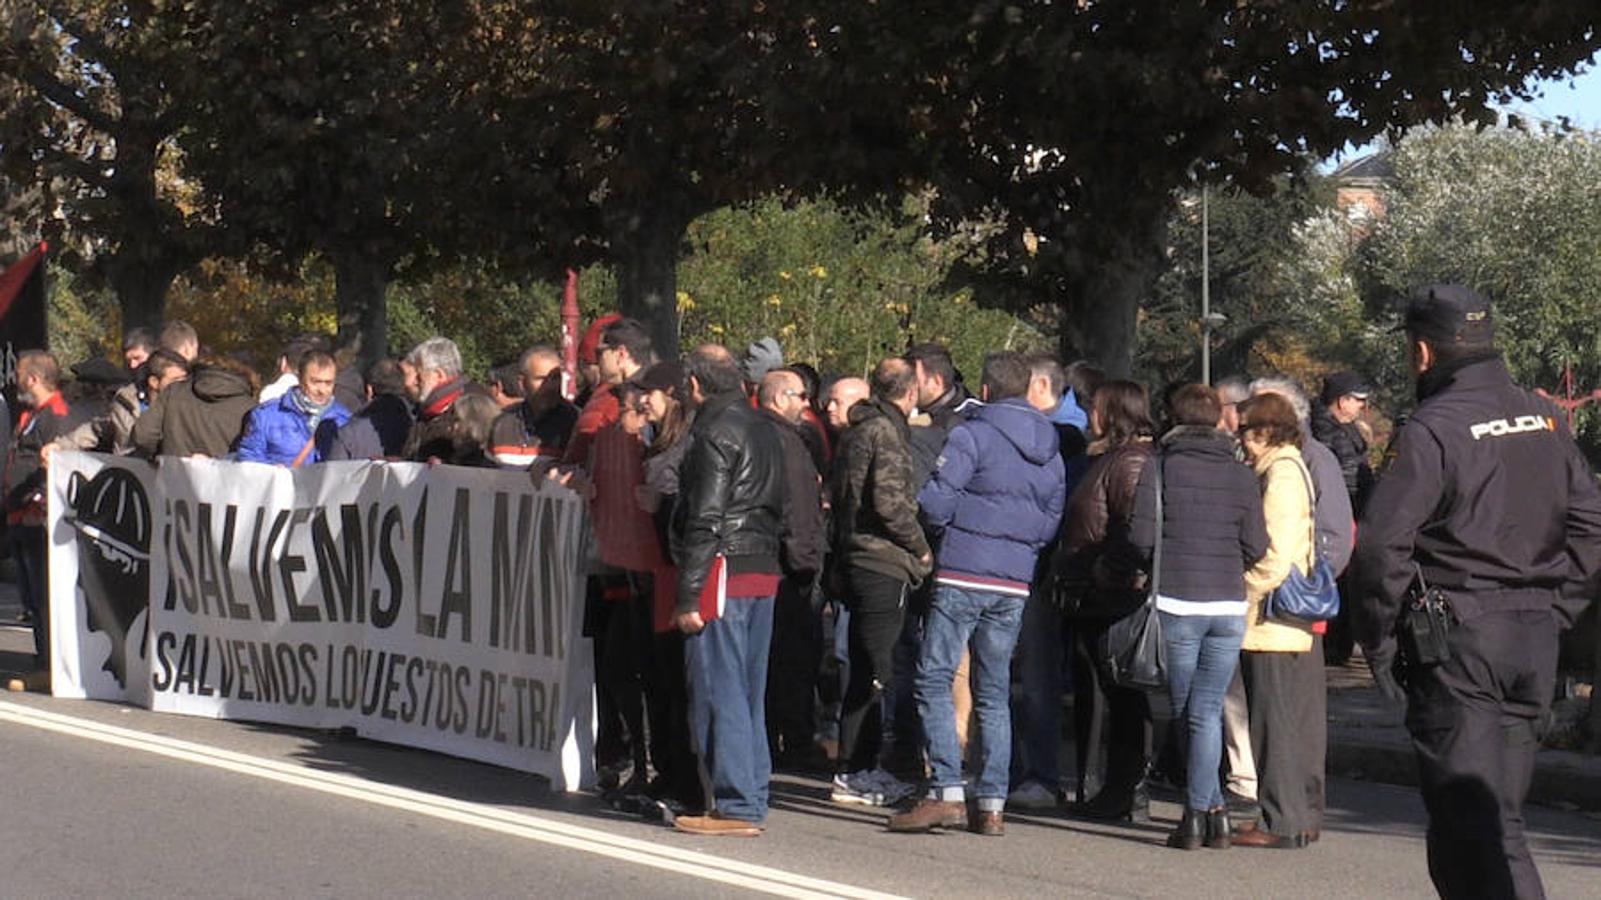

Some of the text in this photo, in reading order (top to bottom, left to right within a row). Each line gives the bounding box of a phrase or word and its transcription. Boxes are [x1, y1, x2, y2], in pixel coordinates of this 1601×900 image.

[163, 498, 405, 629] ¡SALVEMS
[412, 484, 472, 643] LA
[153, 631, 317, 708] SALVEMOS
[476, 668, 508, 744] DE
